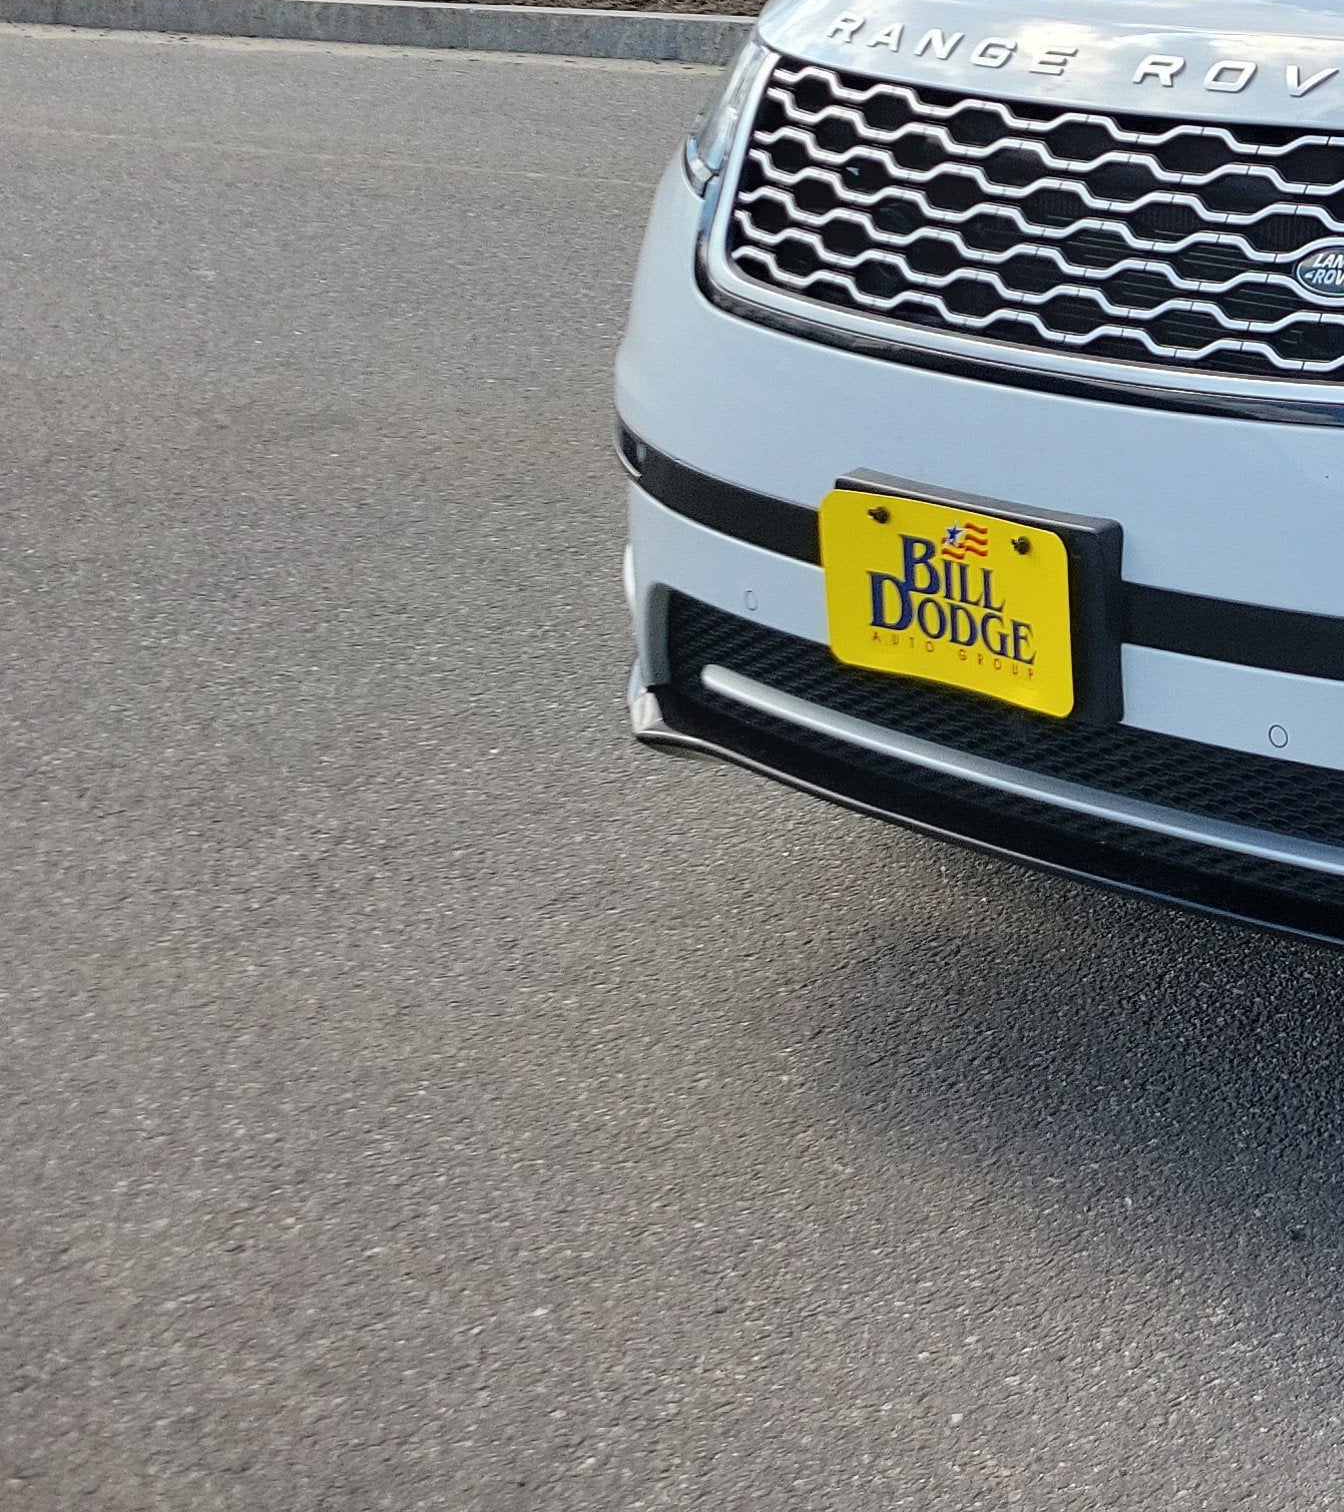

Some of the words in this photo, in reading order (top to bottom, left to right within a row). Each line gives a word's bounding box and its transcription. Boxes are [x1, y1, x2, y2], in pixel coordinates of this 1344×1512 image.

[826, 10, 1079, 76] RANGE
[899, 533, 1006, 613] BILL
[866, 570, 1037, 665] DODGE
[872, 631, 935, 653] AUTO
[958, 648, 1035, 680] GROUP
